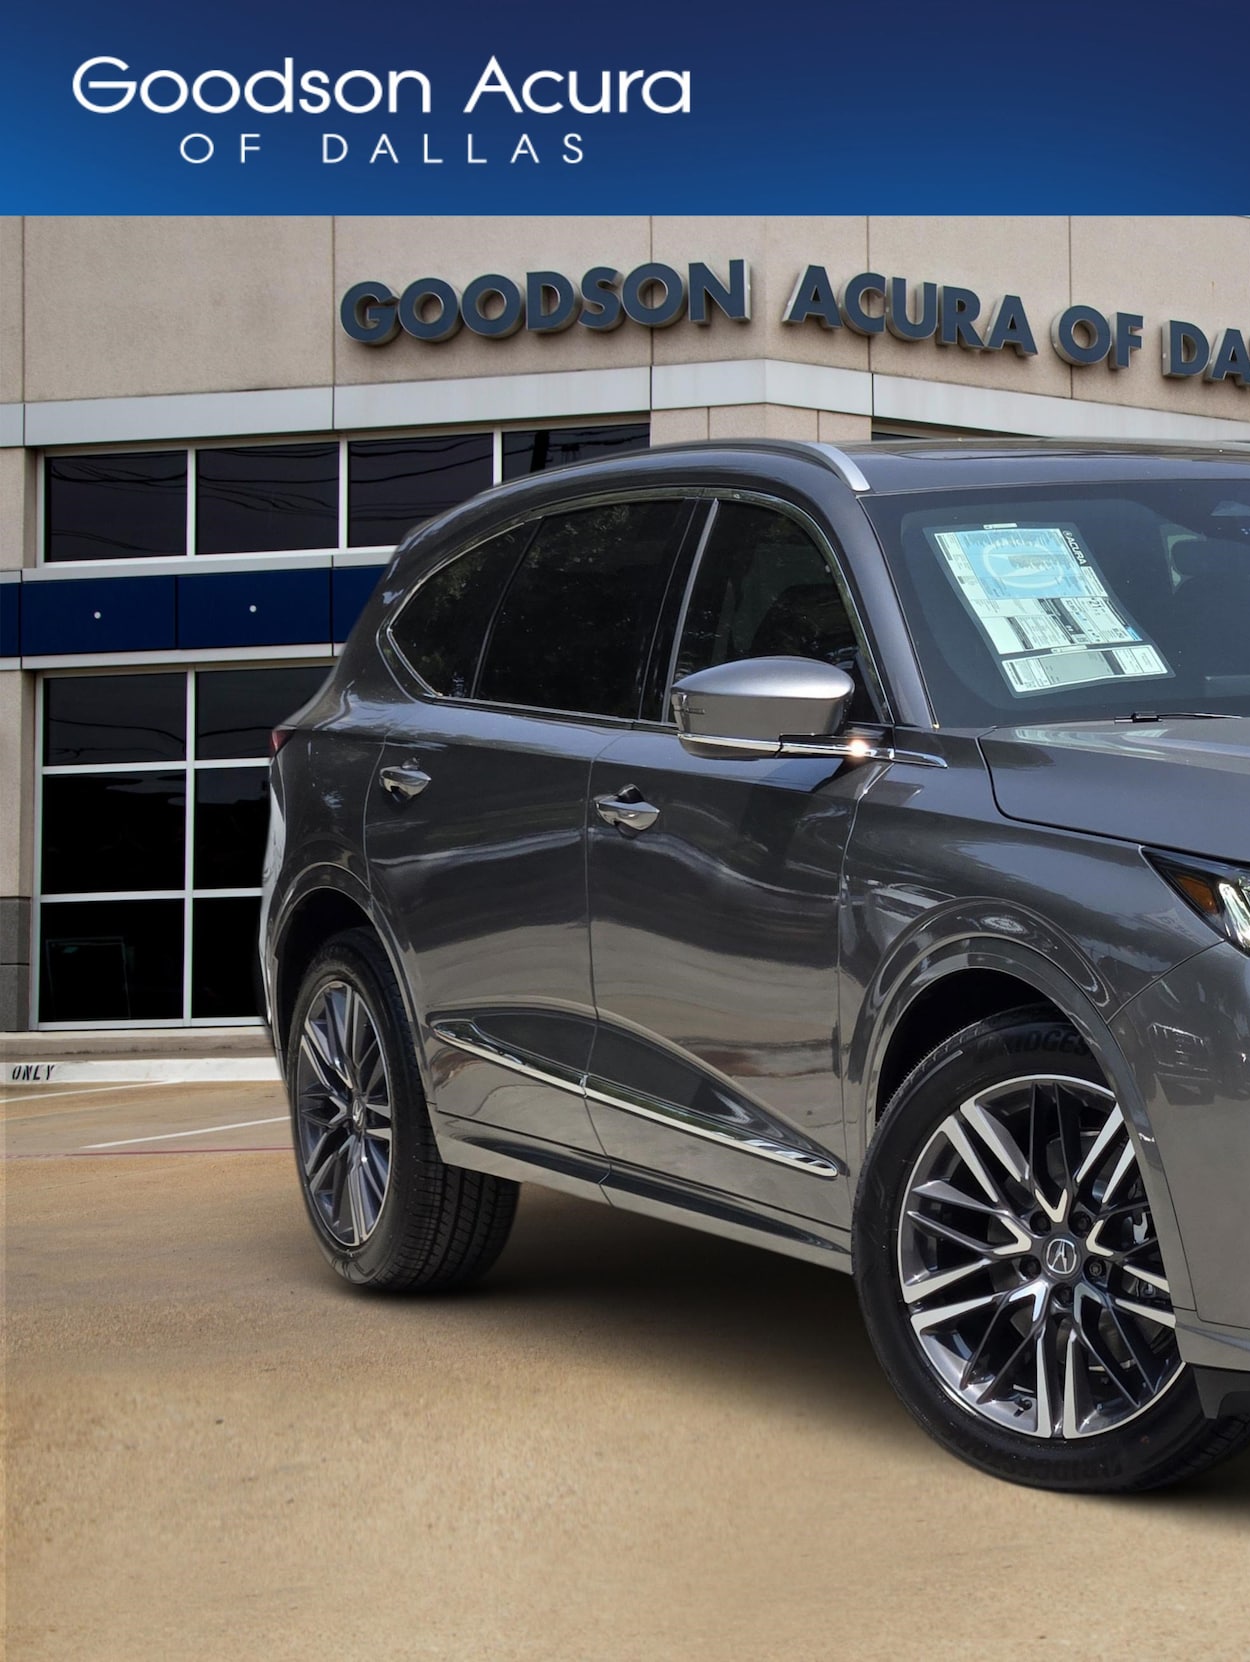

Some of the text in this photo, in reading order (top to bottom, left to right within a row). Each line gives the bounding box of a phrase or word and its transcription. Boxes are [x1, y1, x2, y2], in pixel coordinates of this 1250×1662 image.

[340, 259, 750, 346] GOODSON
[782, 264, 1038, 356] ACURA
[1051, 304, 1144, 370] OF
[1067, 536, 1087, 565] ACURA
[11, 1064, 56, 1081] ONLY
